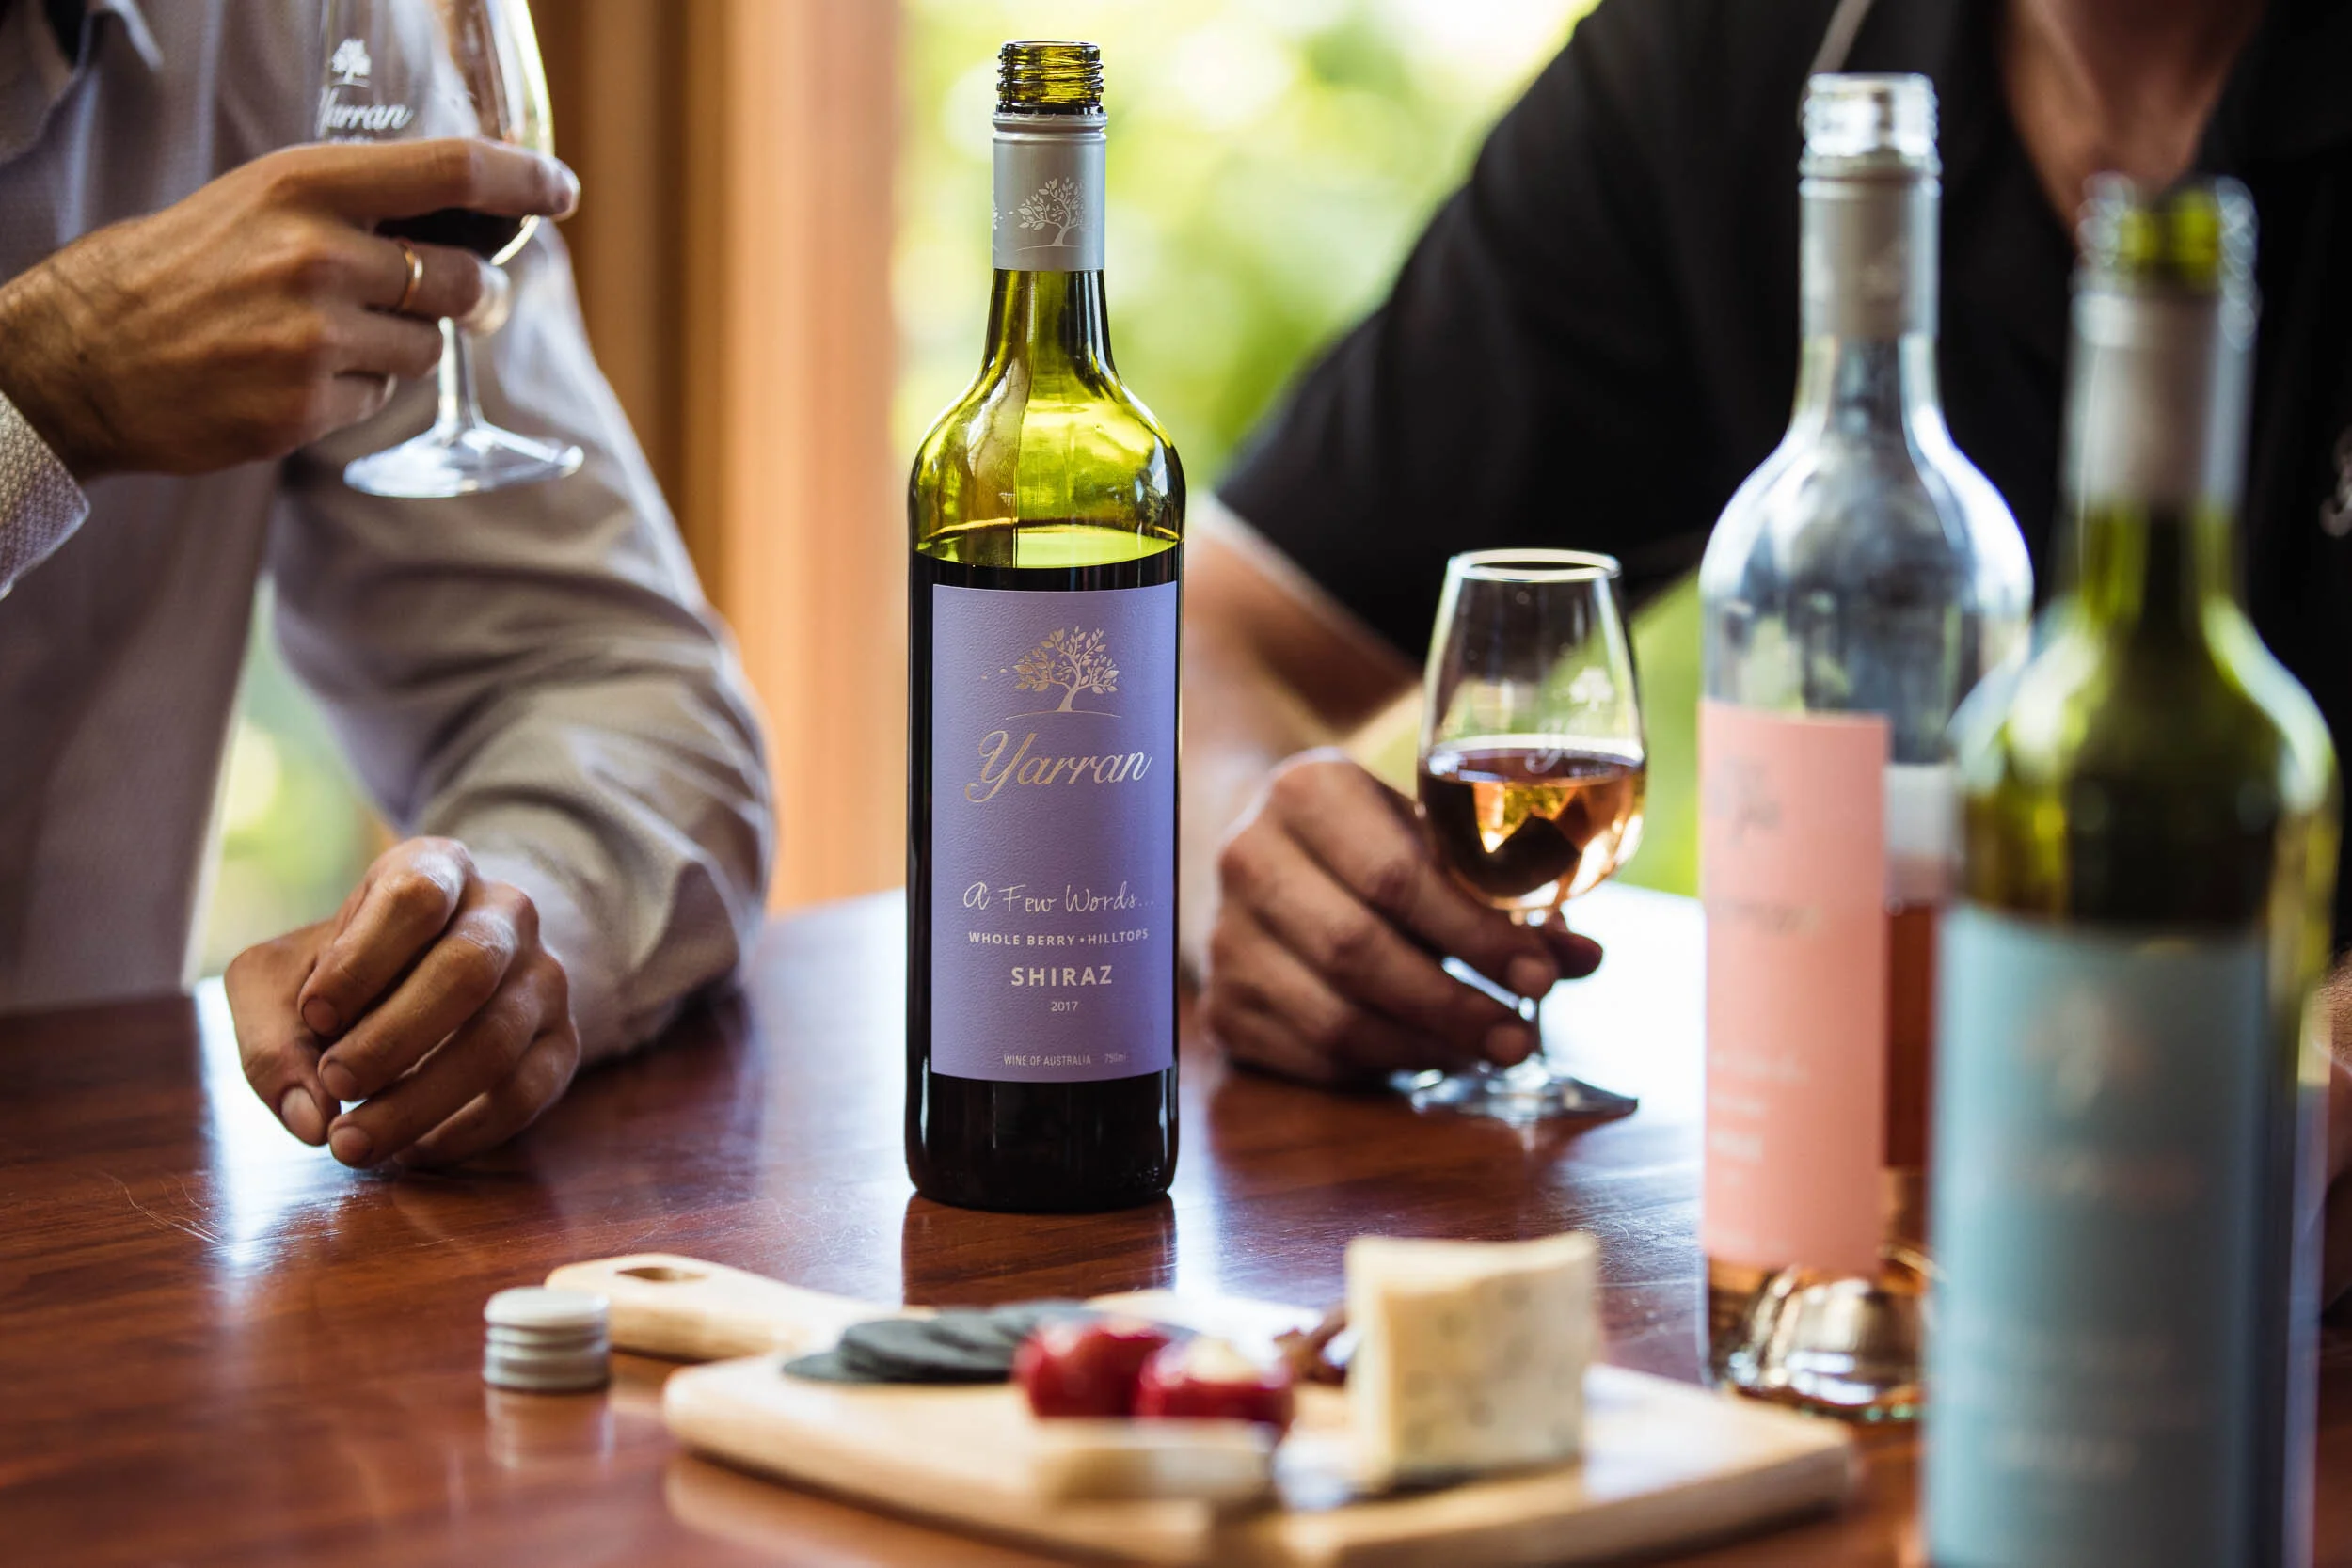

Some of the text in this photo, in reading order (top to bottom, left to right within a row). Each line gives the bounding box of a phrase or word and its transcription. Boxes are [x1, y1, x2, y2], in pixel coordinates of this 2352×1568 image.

[964, 730, 1152, 802] Yarran
[998, 884, 1057, 912] Few
[969, 928, 1149, 946] WHOLE BERRY HILLTOPS
[1010, 965, 1112, 987] SHIRAZ
[1050, 1001, 1079, 1012] 2017
[1003, 1053, 1026, 1066] WINE
[1030, 1054, 1041, 1066] OF
[1043, 1054, 1091, 1066] AUSTRALIA
